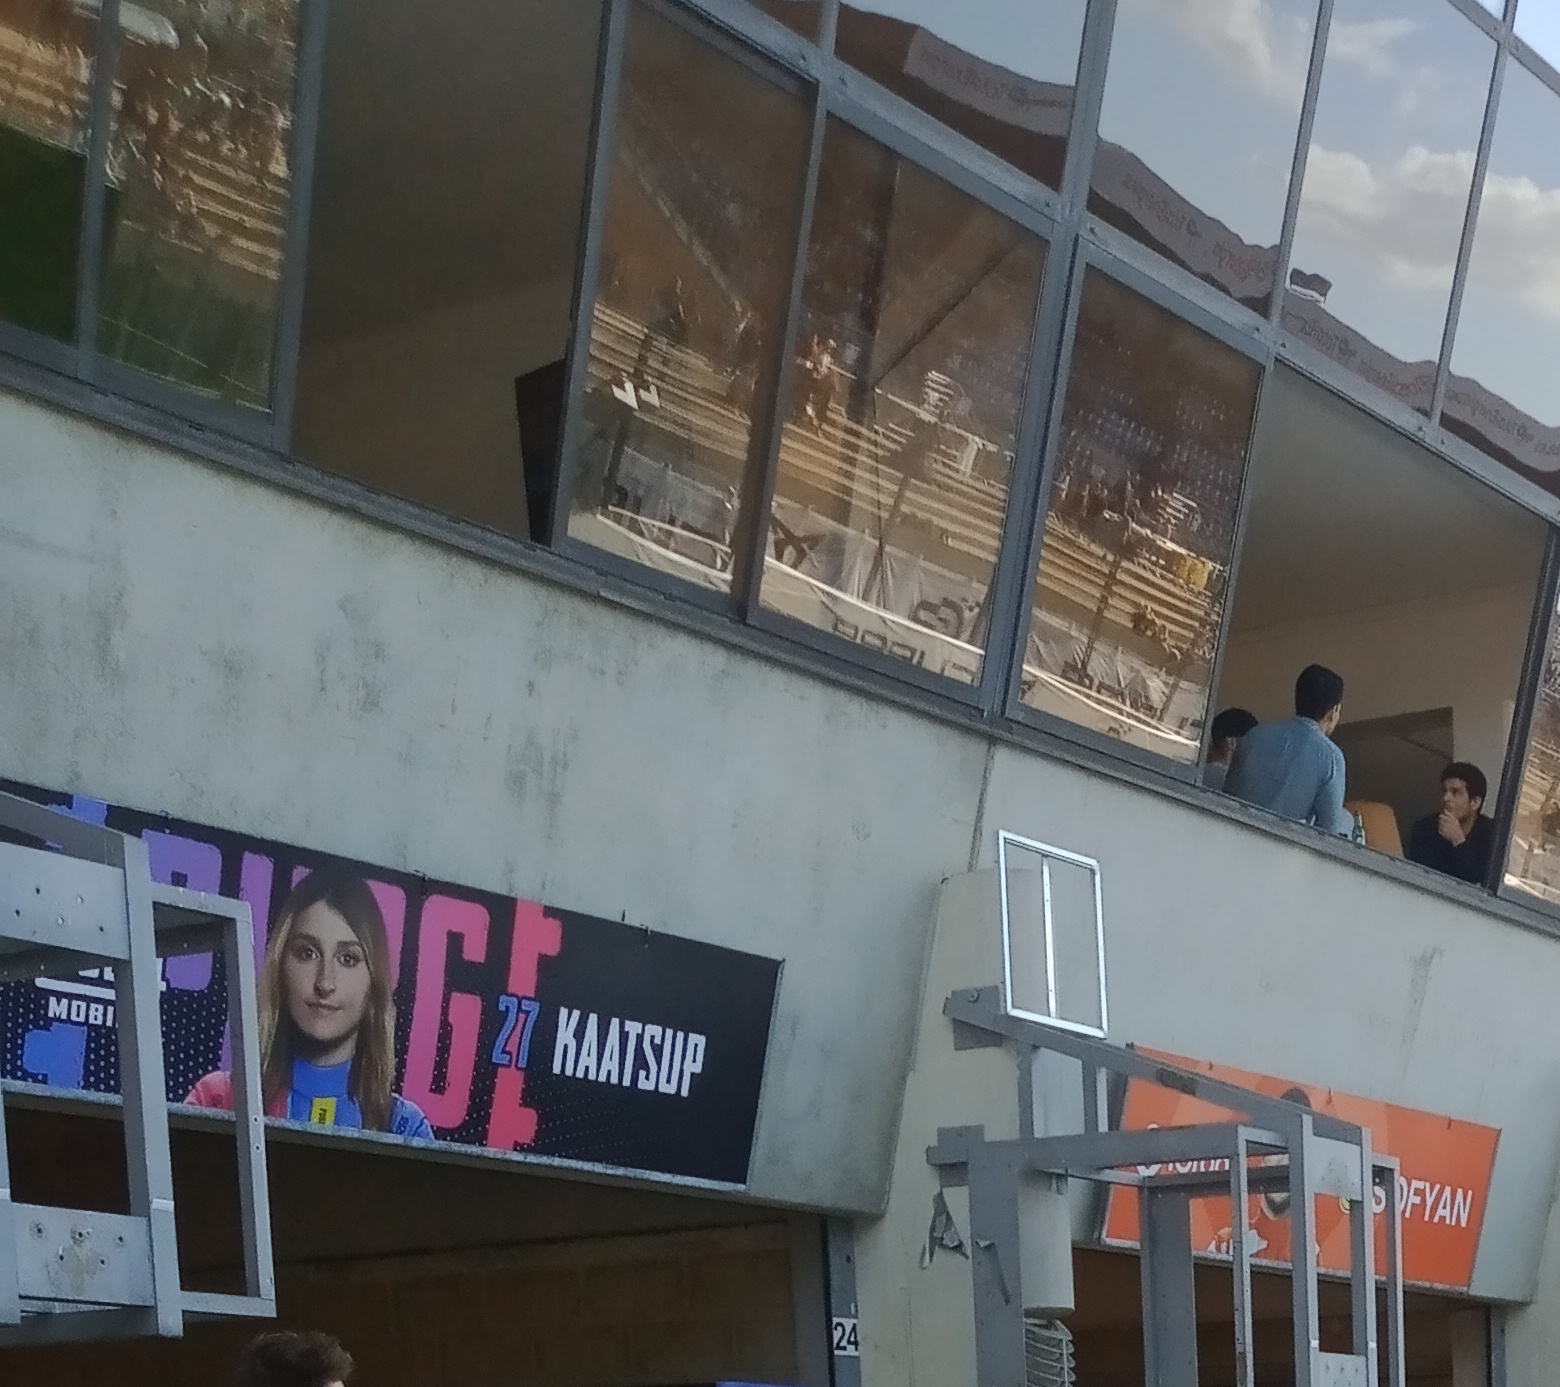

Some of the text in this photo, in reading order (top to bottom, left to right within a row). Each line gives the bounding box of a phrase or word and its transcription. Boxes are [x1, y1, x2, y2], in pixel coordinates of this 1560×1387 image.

[48, 996, 118, 1028] MOBI
[490, 994, 707, 1098] 27 KAATSUP
[833, 1320, 860, 1352] 24
